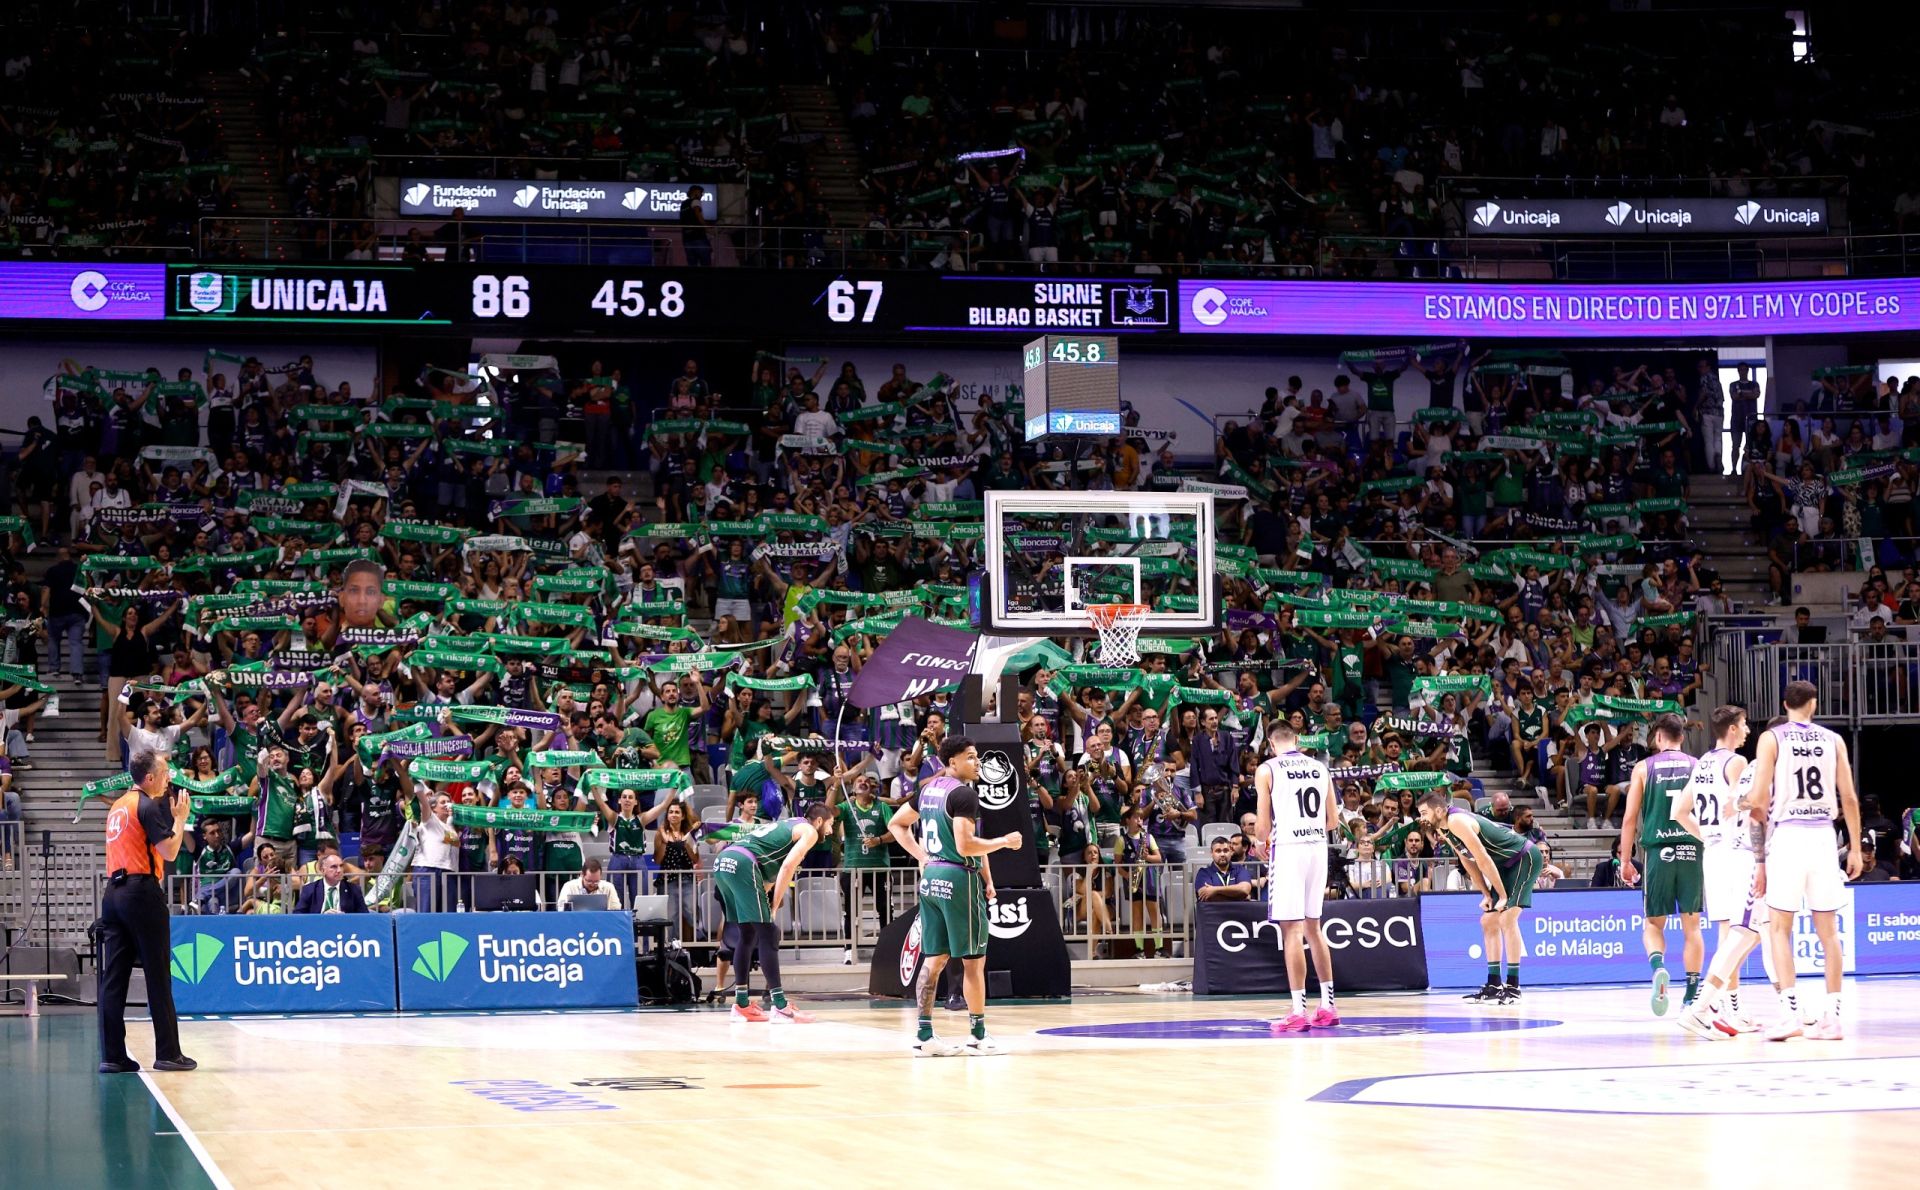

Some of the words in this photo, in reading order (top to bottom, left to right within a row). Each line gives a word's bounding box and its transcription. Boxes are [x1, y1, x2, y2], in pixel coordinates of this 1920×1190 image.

[434, 185, 497, 199] Fundación
[542, 187, 606, 201] Fundación
[433, 196, 479, 211] Unicaja
[542, 198, 589, 213] Unicaja
[1502, 210, 1560, 227] Unicaja
[1634, 209, 1692, 227] Unicaja
[1763, 208, 1820, 225] Unicaja
[111, 282, 136, 291] COPE
[1034, 283, 1103, 304] SURNE
[250, 279, 388, 313] UNICAJA
[472, 274, 530, 318] 86
[591, 279, 685, 318] 45.8
[827, 280, 884, 322] 67
[1230, 298, 1253, 307] COPE
[1230, 305, 1267, 317] MÁLAGA
[1424, 295, 1526, 321] ESTAMOS
[1533, 297, 1561, 321] EN
[1567, 295, 1662, 321] DIRECTO
[1669, 294, 1698, 320] EN
[1703, 294, 1746, 320] 97.1
[1752, 293, 1784, 318] FM
[1791, 293, 1803, 317] Y
[1809, 291, 1900, 317] COPE.es
[969, 307, 1030, 327] BILBAO
[1035, 307, 1103, 327] BASKET
[1052, 342, 1101, 362] 45.8
[1075, 419, 1115, 432] Unicaja
[1830, 473, 1856, 486] Unicaja
[1857, 463, 1895, 479] Baloncesto
[101, 508, 169, 523] UNICAJA
[1525, 513, 1578, 531] UNICAJA
[528, 537, 562, 551] icaja
[1014, 537, 1058, 549] Baloncesto
[297, 590, 338, 606] ICAJA
[341, 627, 419, 643] UNICAJA
[676, 654, 706, 662] UNICAJA
[900, 652, 970, 671] FONDO
[541, 665, 559, 676] TAU
[230, 671, 308, 687] UNICAJA
[500, 709, 554, 725] Baloncesto
[1388, 716, 1459, 736] UNICAJA
[391, 743, 423, 756] UNICAJA
[424, 739, 469, 756] BALONCESTO
[425, 762, 465, 774] Unicaja
[1286, 770, 1311, 780] bbk
[617, 771, 656, 782] Unicaja
[1794, 766, 1824, 801] 18
[978, 784, 1009, 798] Risi
[1295, 786, 1321, 818] 10
[1695, 793, 1719, 826] 21
[503, 811, 545, 822] Unicaja
[1789, 807, 1831, 817] vueling
[109, 816, 122, 833] 44
[1293, 826, 1325, 838] vueling
[931, 878, 953, 888] COSTA
[940, 886, 953, 895] SOL
[987, 897, 1029, 924] isi
[1534, 914, 1626, 935] Diputación
[1867, 913, 1880, 927] El
[1216, 914, 1417, 953] enesa
[1867, 931, 1893, 945] que
[233, 934, 381, 960] Fundación
[478, 932, 622, 959] Fundación
[1535, 940, 1554, 957] de
[1561, 937, 1624, 961] Málaga
[235, 962, 341, 991] Unicaja
[479, 959, 584, 989] Unicaja
